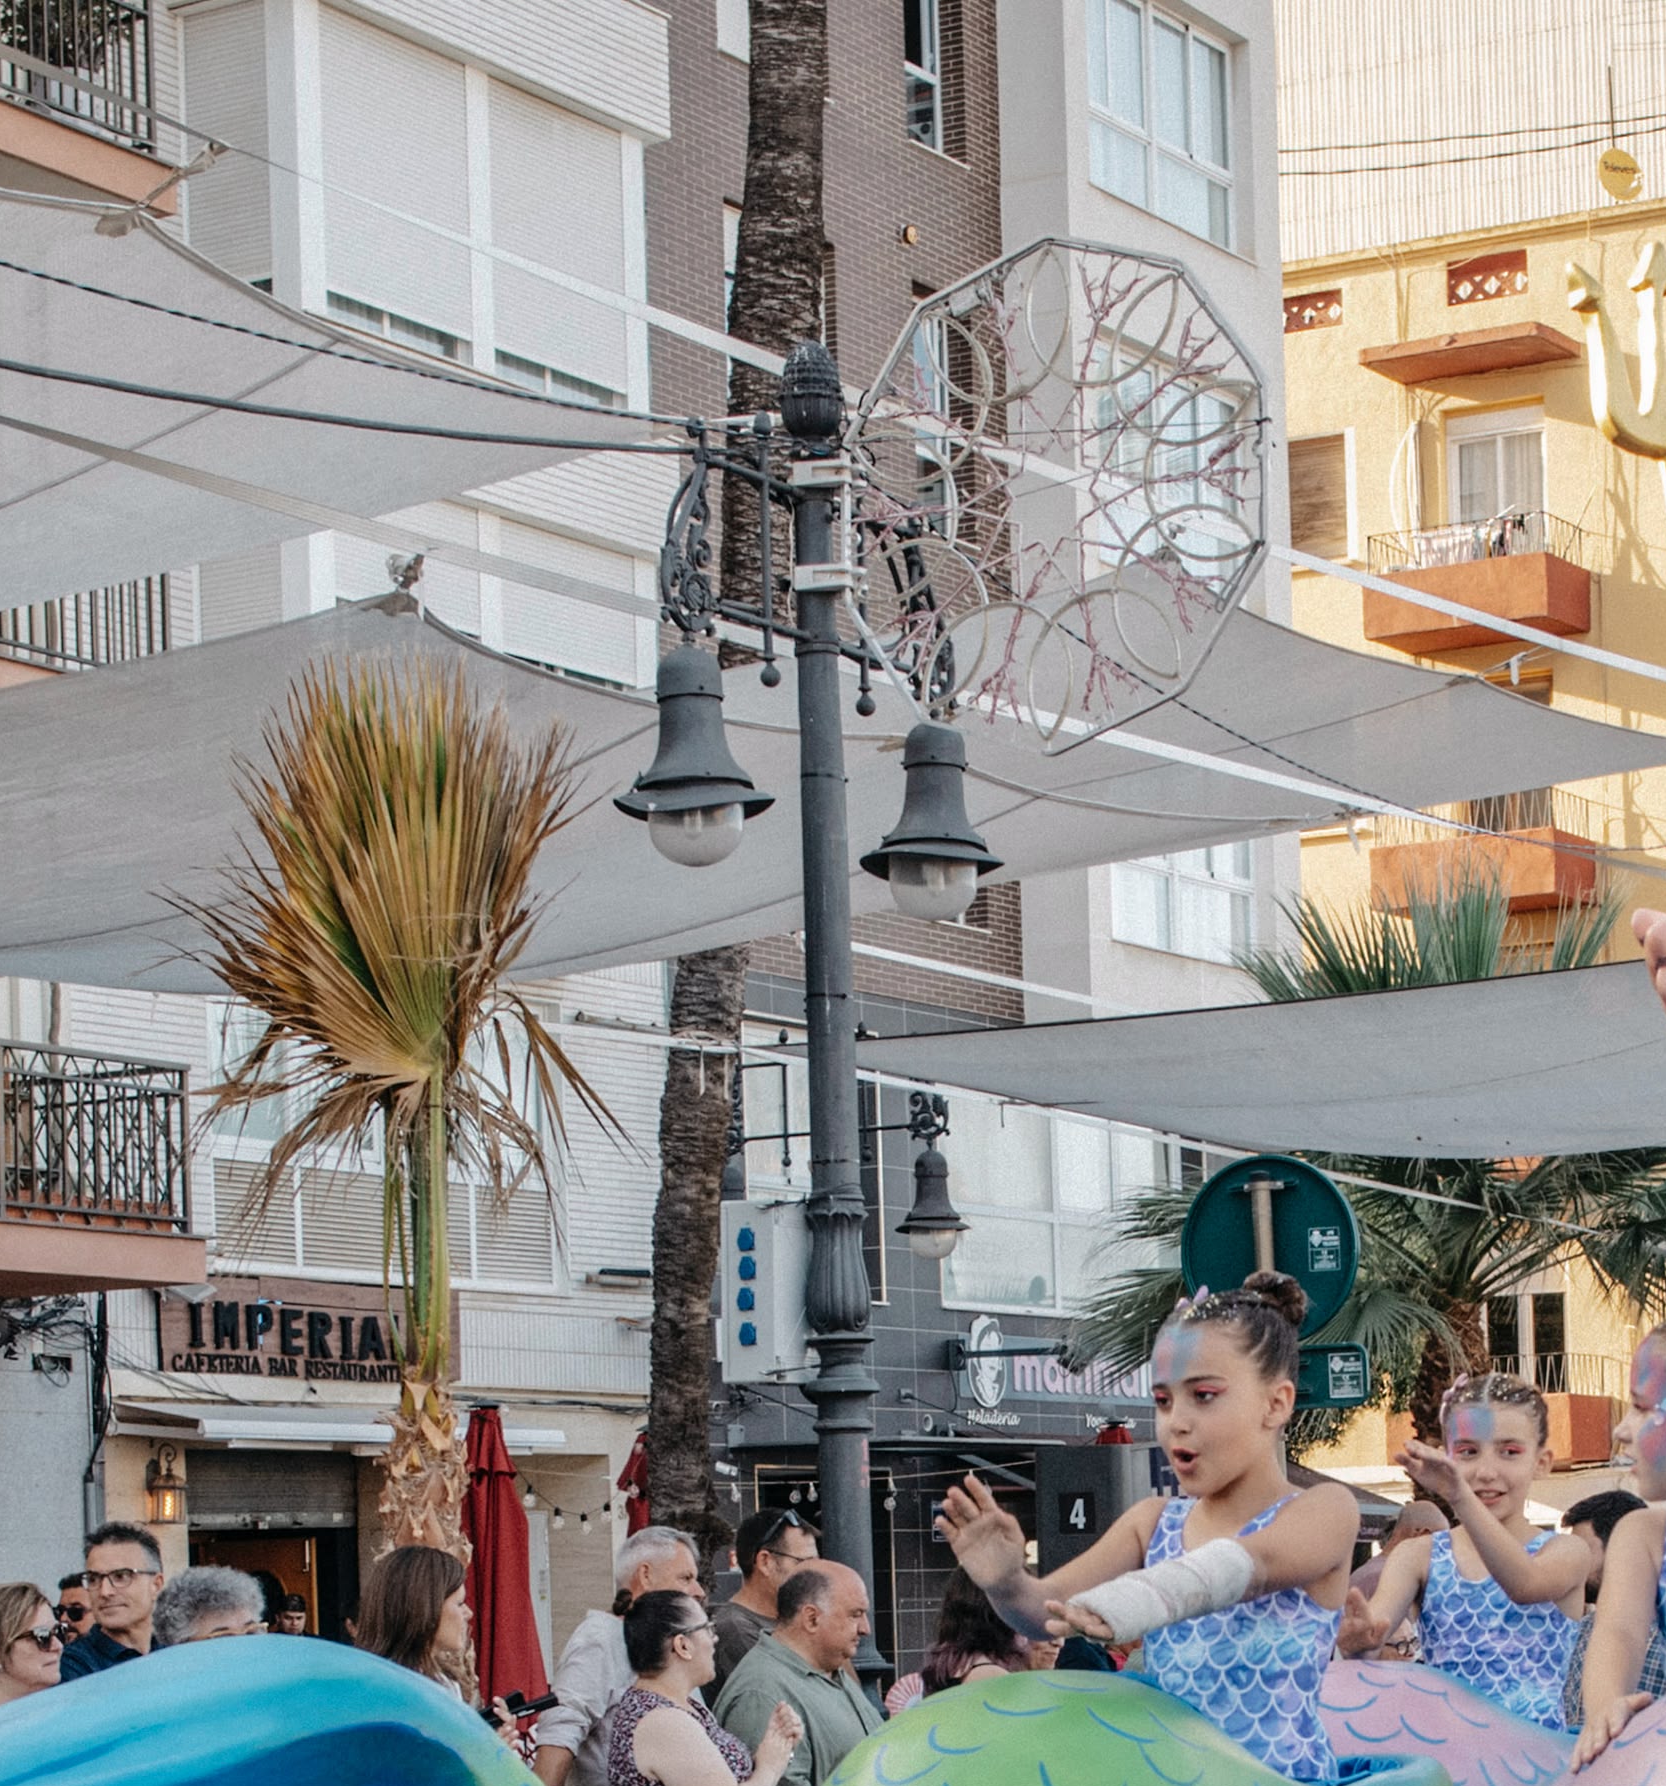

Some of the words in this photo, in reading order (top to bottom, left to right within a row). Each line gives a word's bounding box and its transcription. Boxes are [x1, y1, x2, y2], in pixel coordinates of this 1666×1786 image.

[171, 1353, 262, 1375] CAFETERIA
[268, 1359, 298, 1377] BAR
[1069, 1498, 1086, 1530] 4
